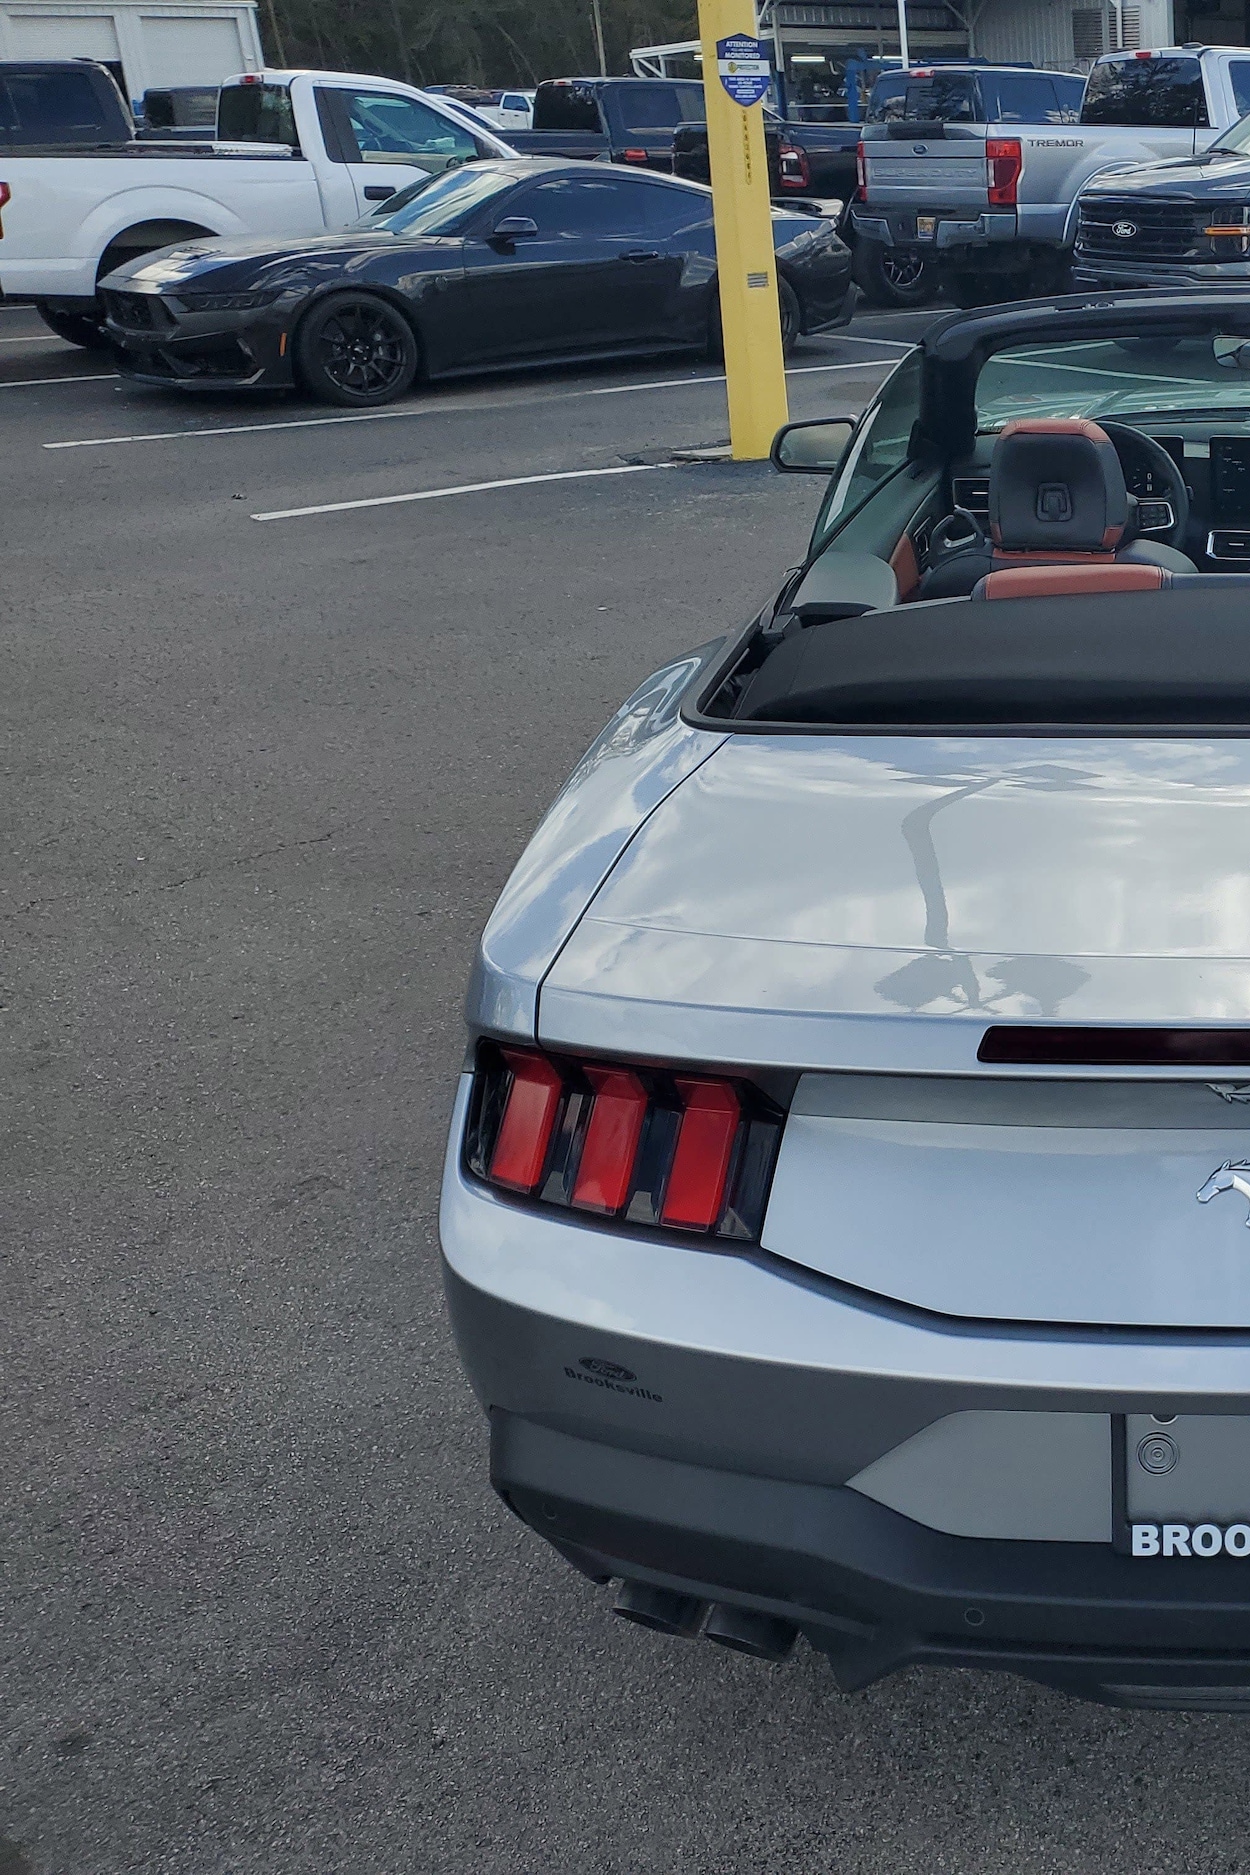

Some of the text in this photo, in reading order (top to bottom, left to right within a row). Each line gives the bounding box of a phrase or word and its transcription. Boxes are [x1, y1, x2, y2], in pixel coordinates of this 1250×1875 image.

[1027, 139, 1084, 147] TREMOR
[1114, 222, 1133, 236] Ford
[563, 1366, 663, 1403] Brooksville
